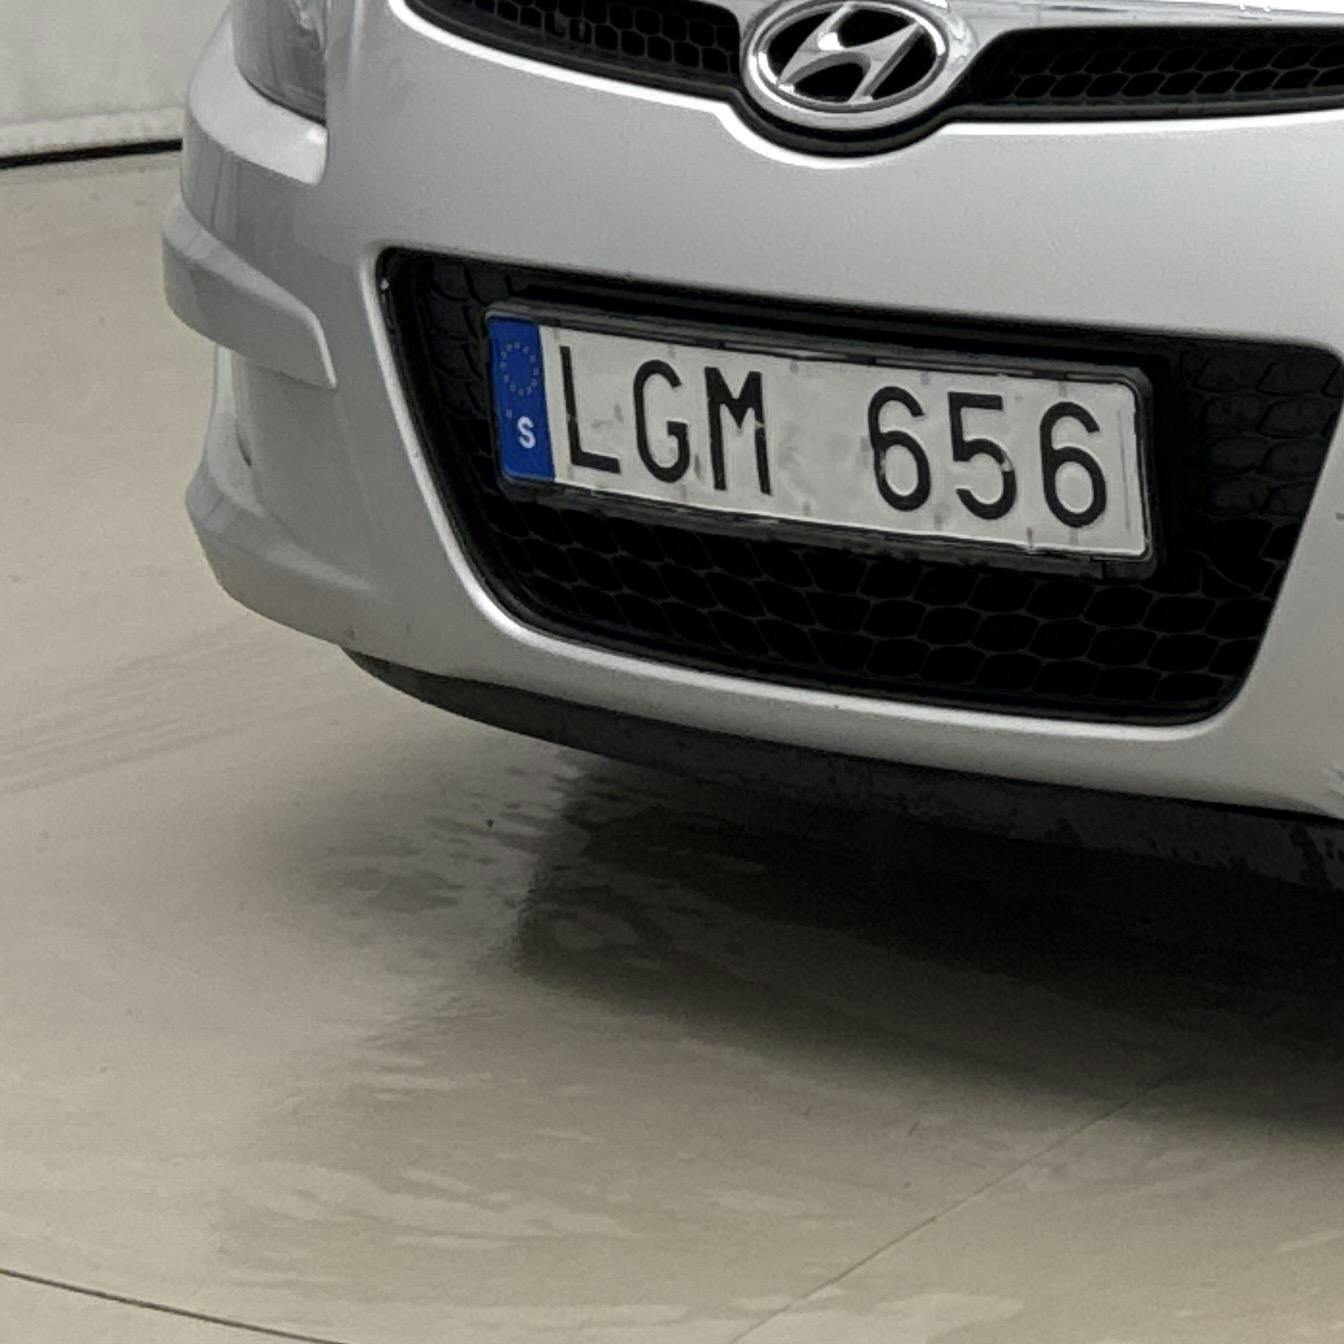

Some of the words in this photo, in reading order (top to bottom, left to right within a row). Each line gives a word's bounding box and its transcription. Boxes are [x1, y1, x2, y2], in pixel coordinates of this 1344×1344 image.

[517, 416, 536, 449] S
[560, 346, 772, 496] LGM
[867, 386, 1108, 529] 656
